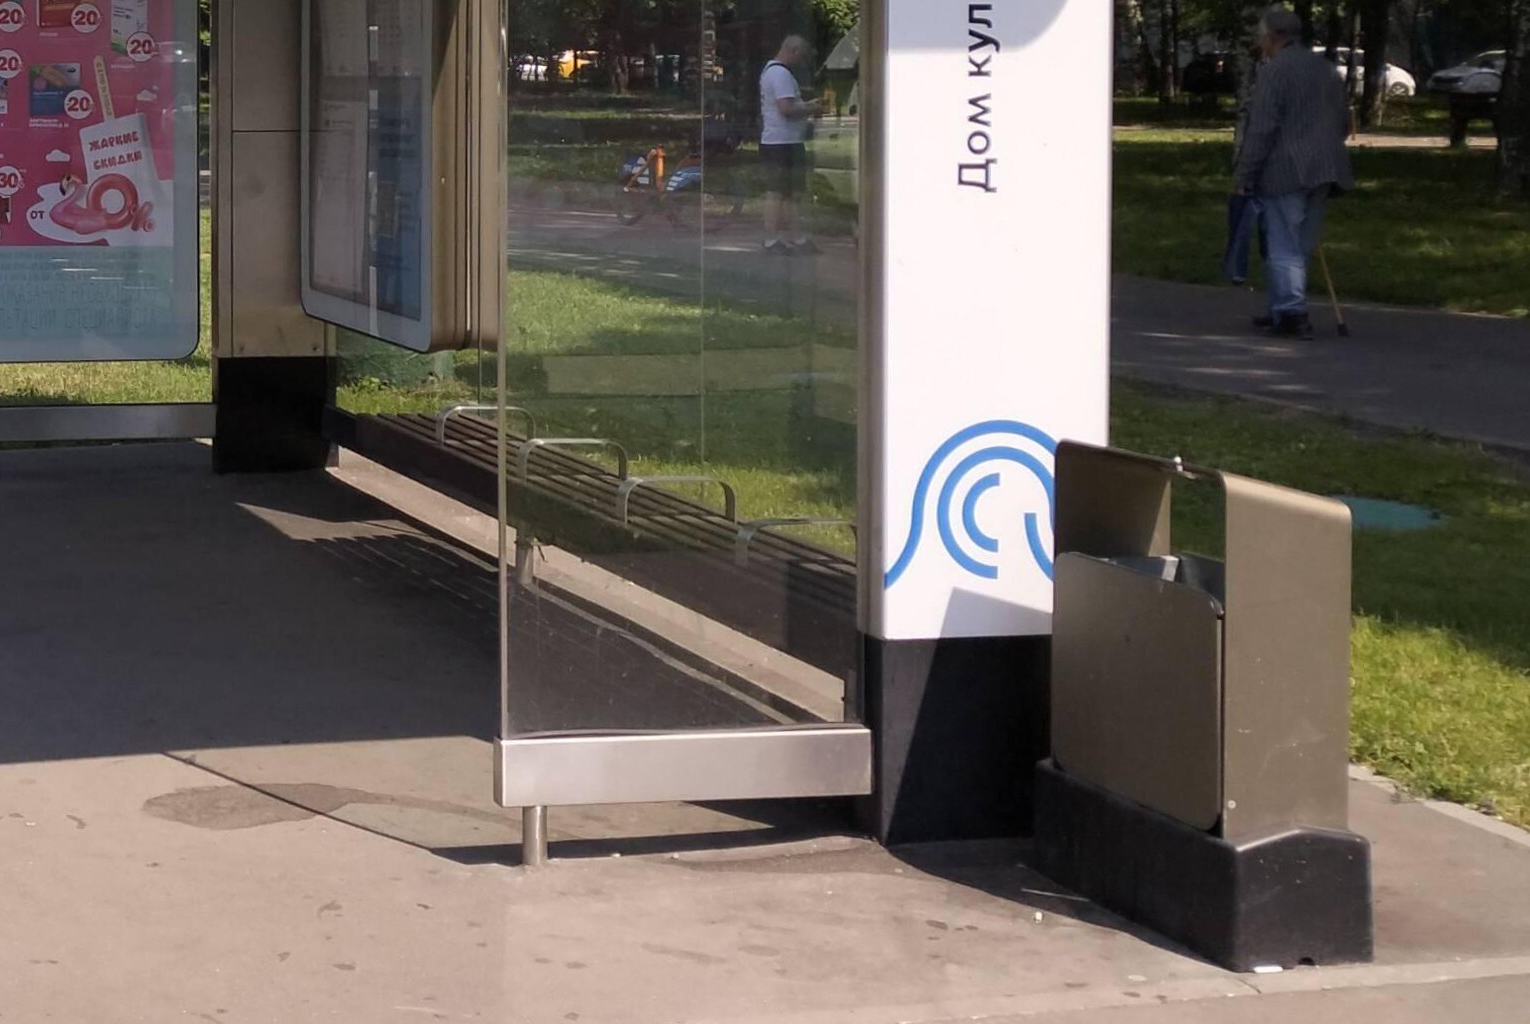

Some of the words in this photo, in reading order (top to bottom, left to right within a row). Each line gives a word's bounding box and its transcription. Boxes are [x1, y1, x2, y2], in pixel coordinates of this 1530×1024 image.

[89, 131, 139, 151] ЖАРКИЕ
[957, 92, 997, 193] Дом
[93, 151, 143, 170] СКИДКИ
